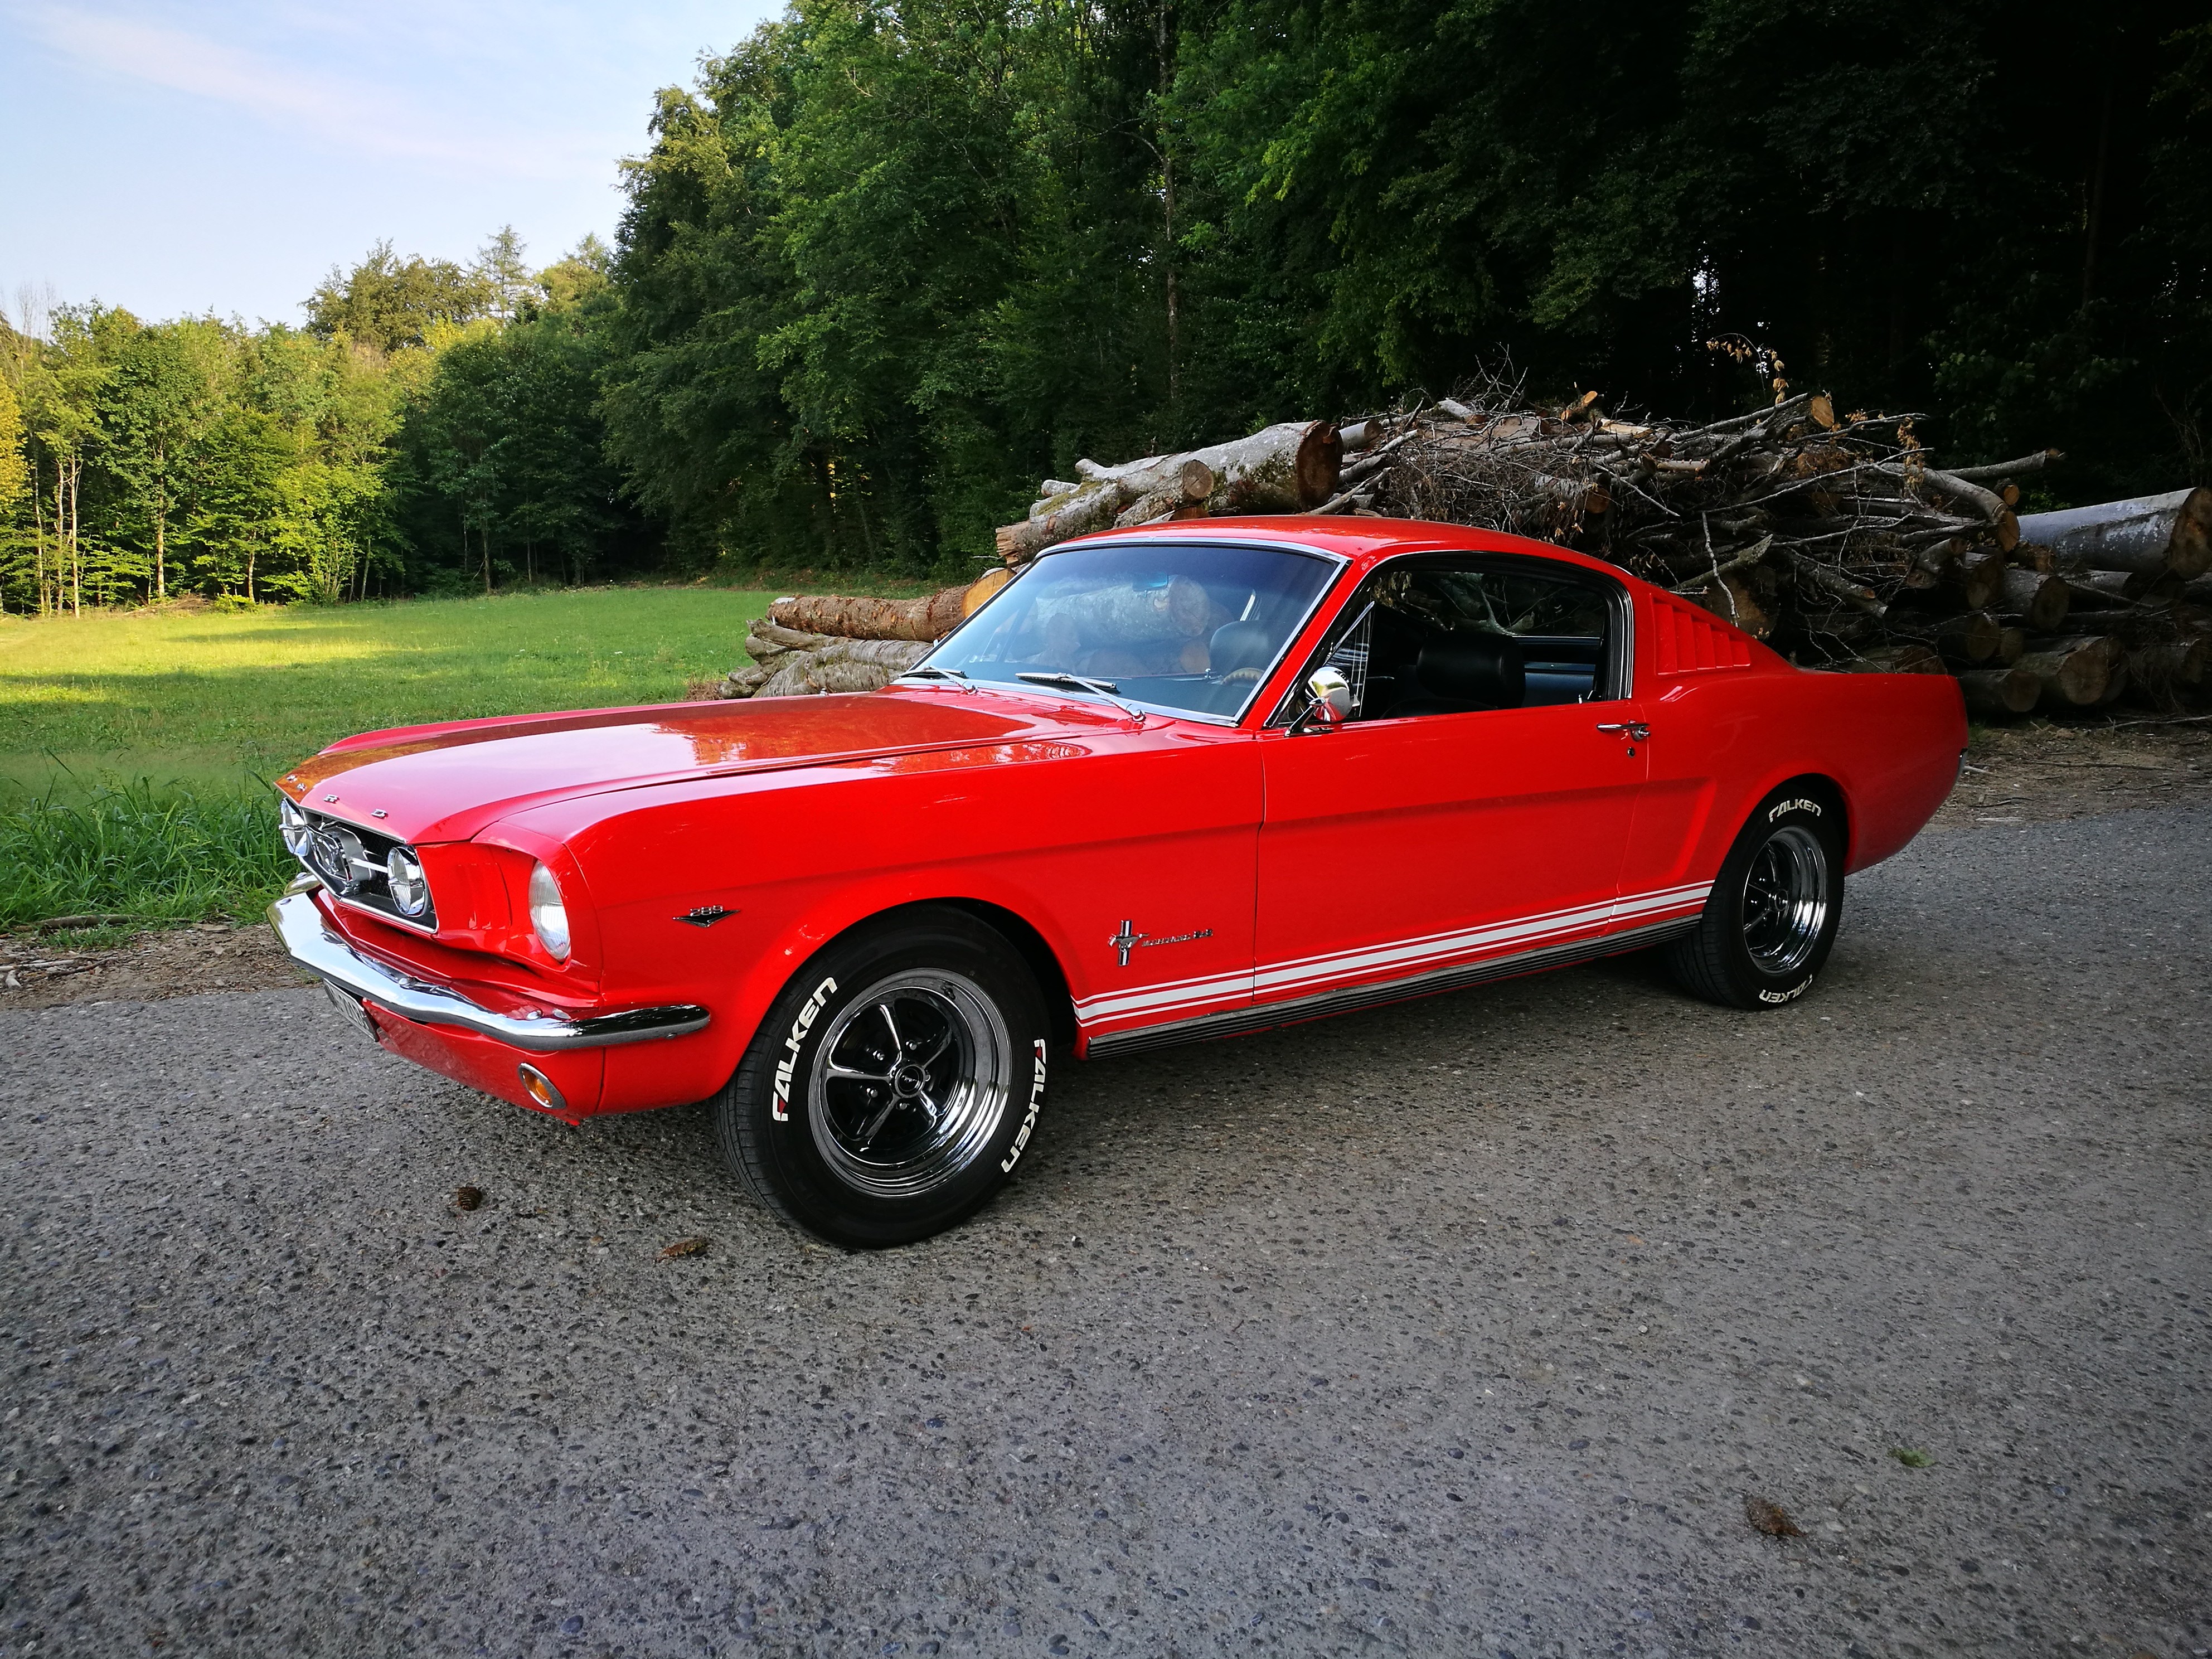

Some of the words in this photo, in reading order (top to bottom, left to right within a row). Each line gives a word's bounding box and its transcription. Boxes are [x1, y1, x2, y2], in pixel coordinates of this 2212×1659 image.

[1768, 799, 1822, 823] FALKEN
[690, 905, 723, 916] 289
[772, 977, 838, 1122] FALKEN
[1001, 1039, 1046, 1173] FALKEN
